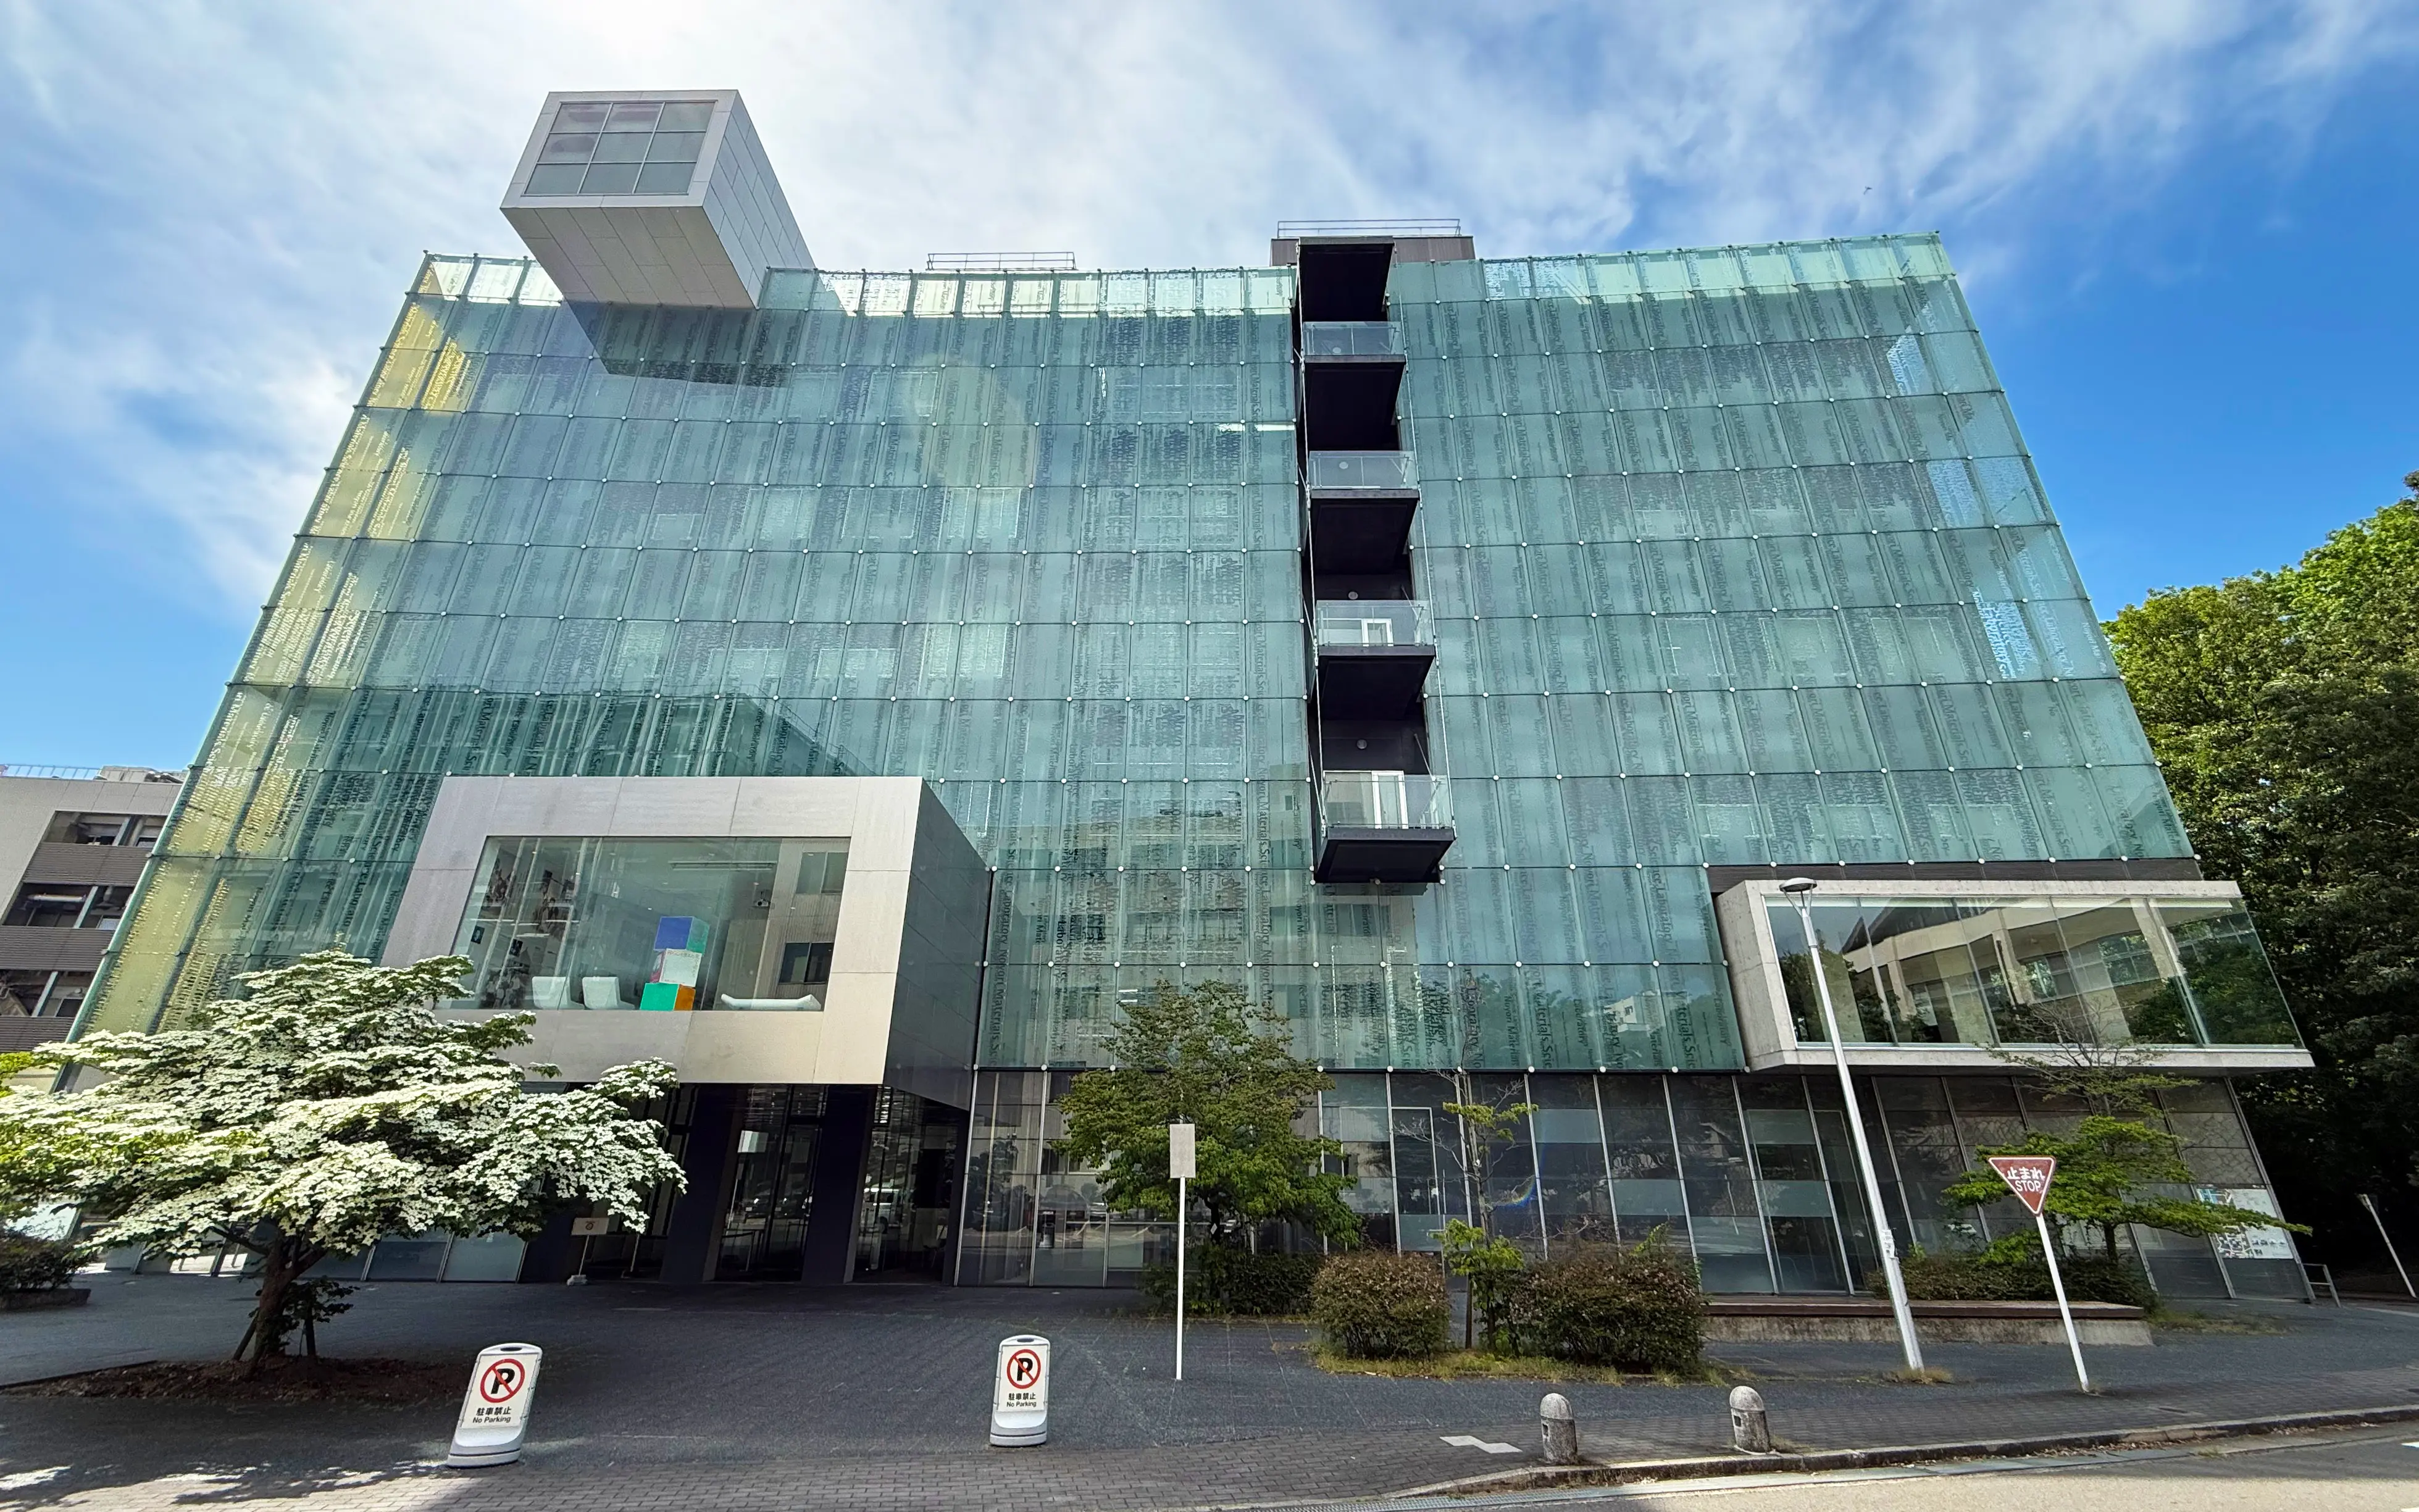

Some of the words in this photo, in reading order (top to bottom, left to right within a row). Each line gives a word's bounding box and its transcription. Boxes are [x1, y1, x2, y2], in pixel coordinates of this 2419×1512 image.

[2007, 1166, 2045, 1180] 止まれ
[2015, 1180, 2041, 1192] STOP
[1008, 1392, 1037, 1401] 駐車禁止
[476, 1406, 511, 1416] 駐車禁止
